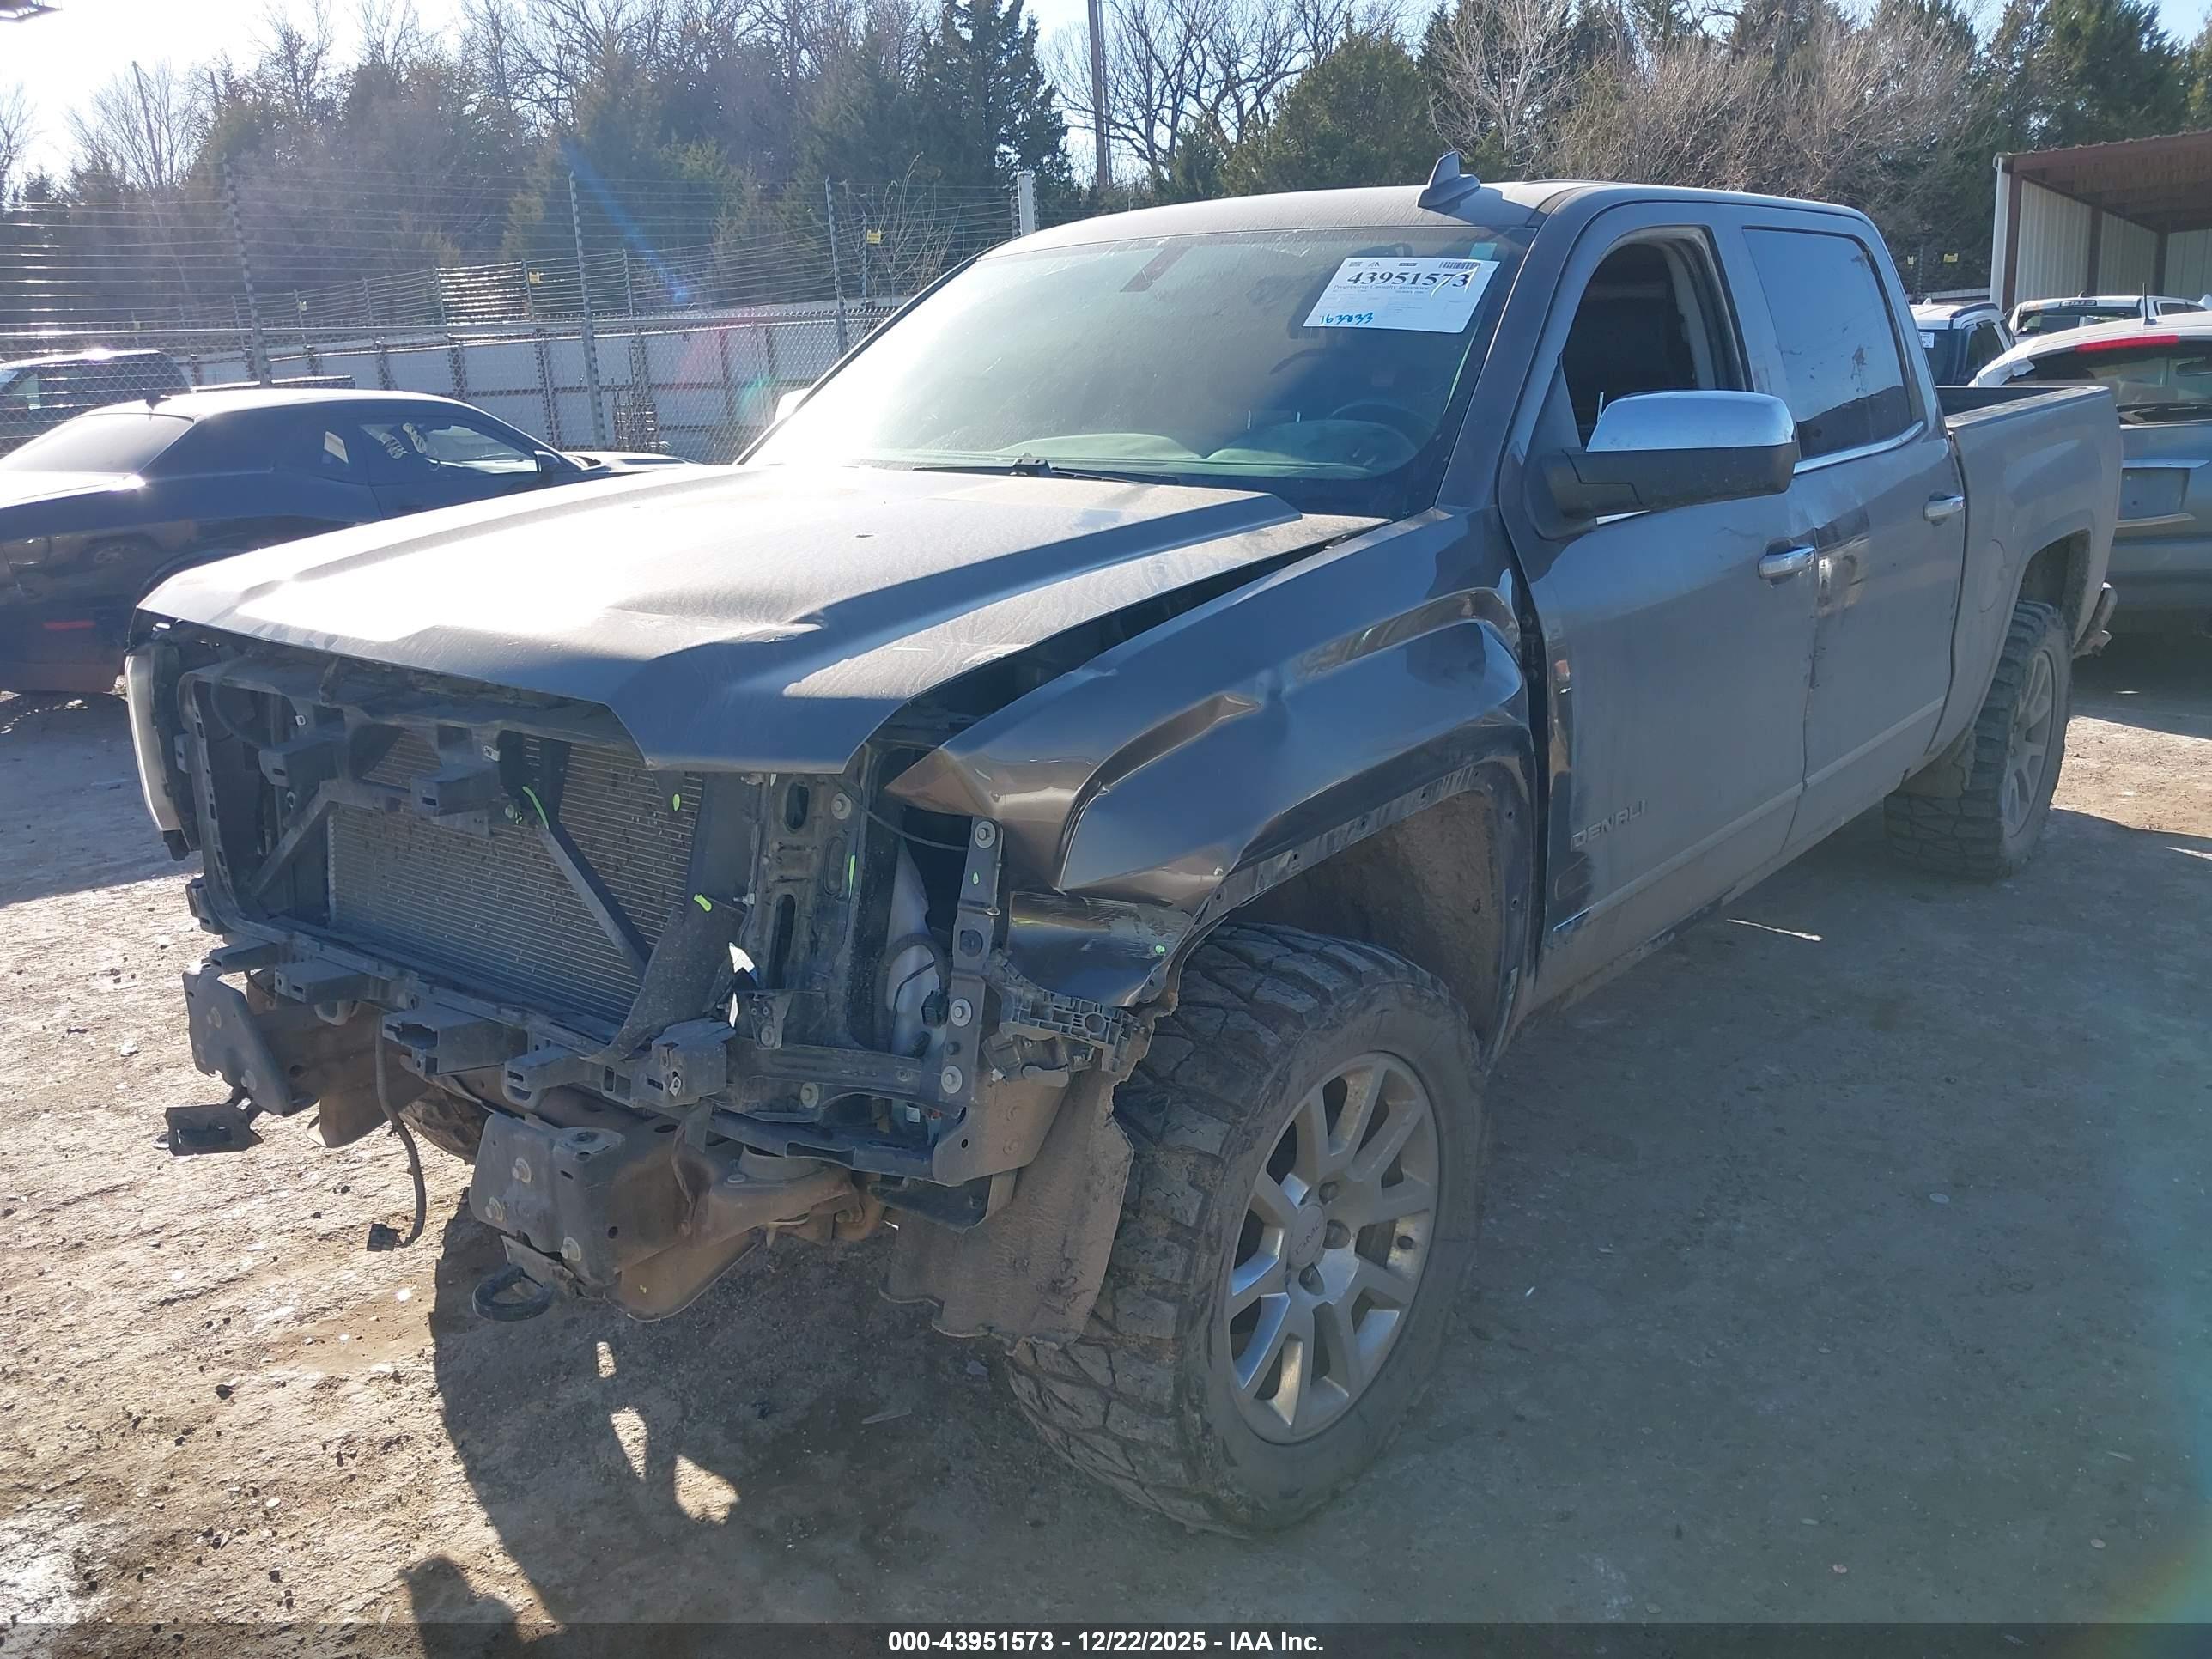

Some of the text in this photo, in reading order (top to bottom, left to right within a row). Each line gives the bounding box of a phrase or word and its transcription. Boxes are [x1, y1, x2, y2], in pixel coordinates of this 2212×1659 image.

[1347, 272, 1470, 287] 43951573
[1570, 799, 1646, 853] DENALI
[1295, 1221, 1320, 1255] GMC
